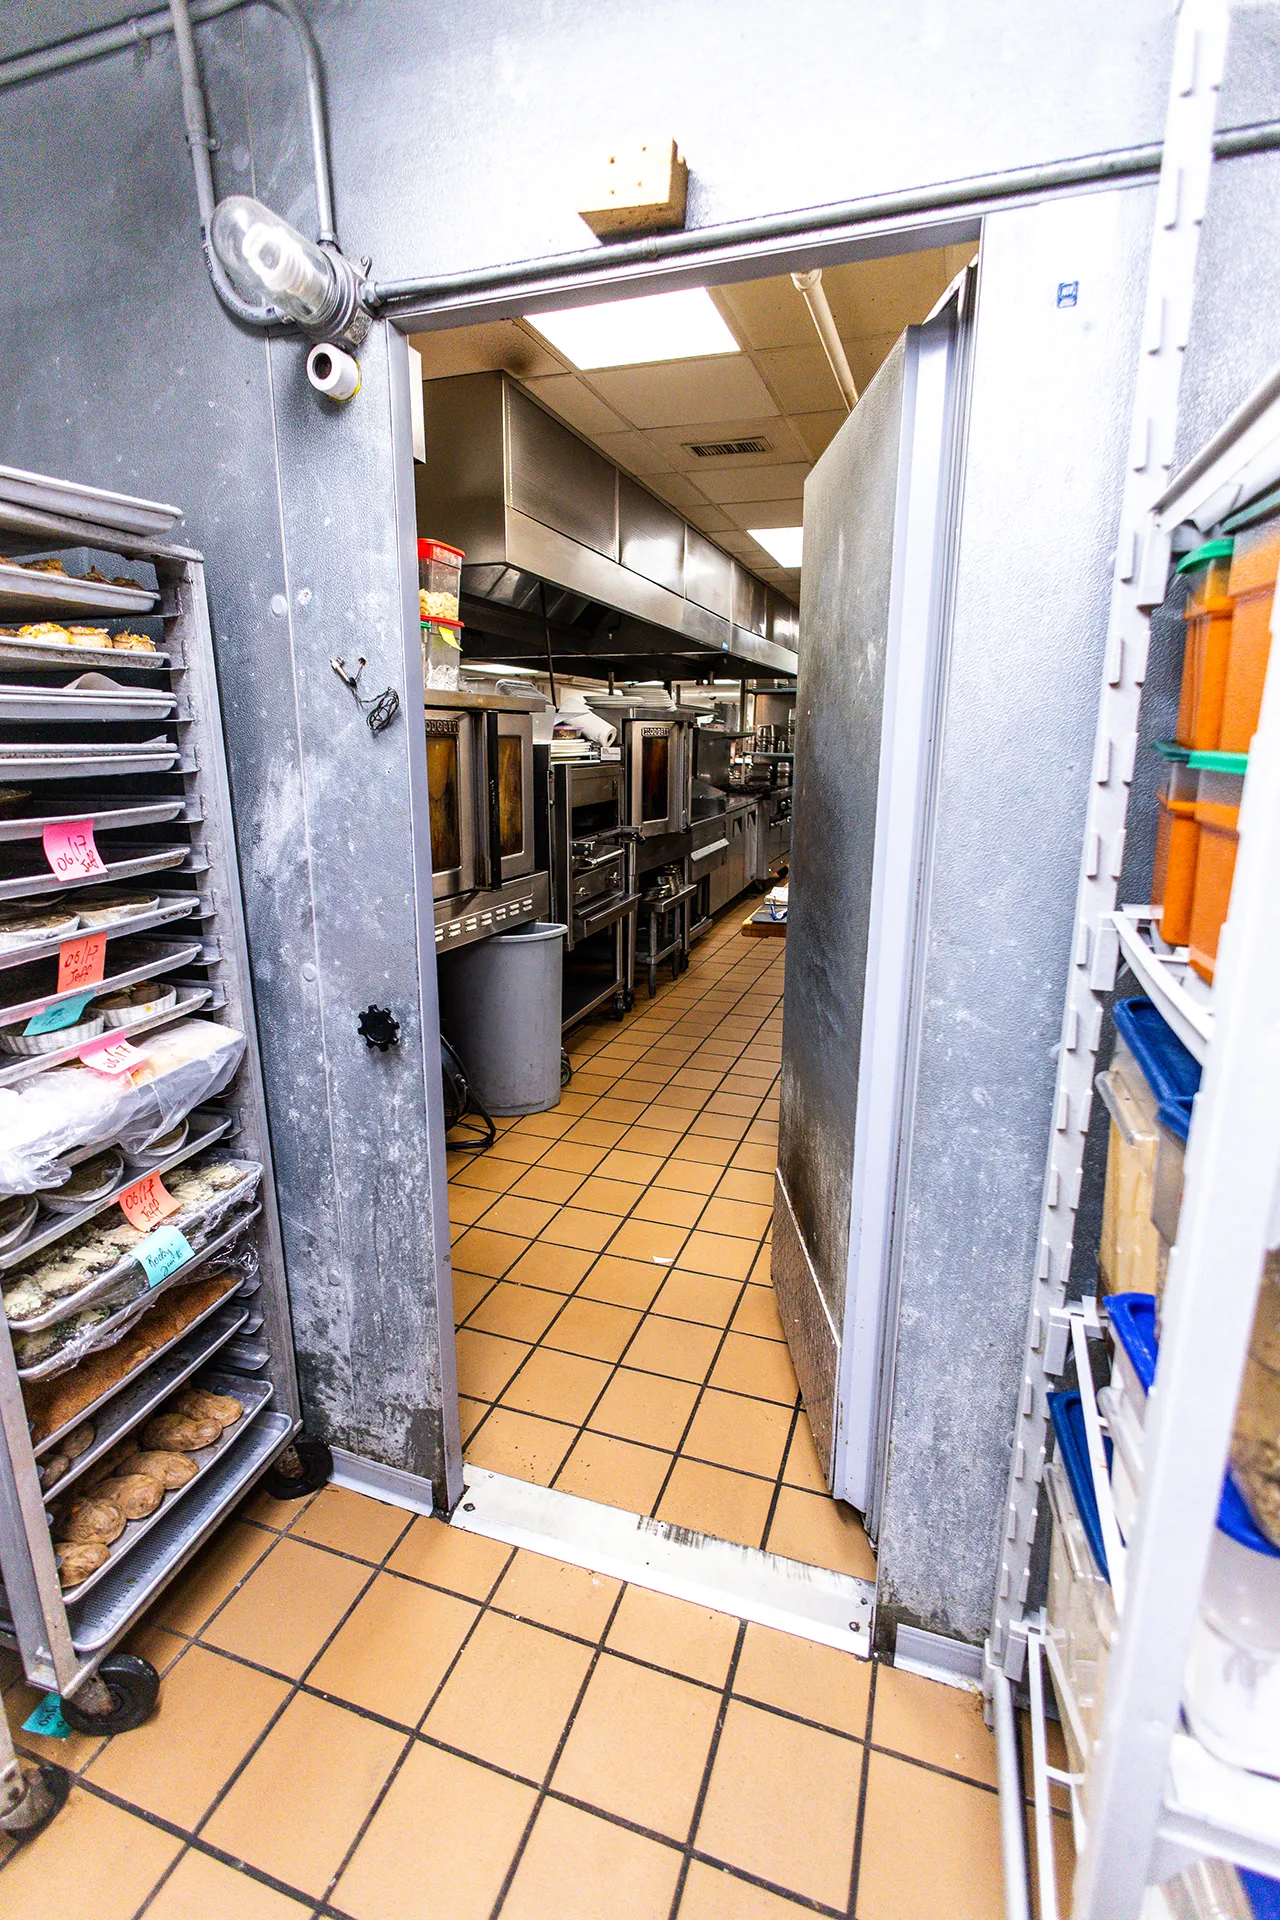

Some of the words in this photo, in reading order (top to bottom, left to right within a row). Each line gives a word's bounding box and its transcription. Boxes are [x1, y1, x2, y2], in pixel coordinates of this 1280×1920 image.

[425, 720, 457, 732] ODGETT
[56, 834, 87, 872] 06/17
[64, 940, 99, 968] 06/17
[125, 1178, 155, 1209] 06/17
